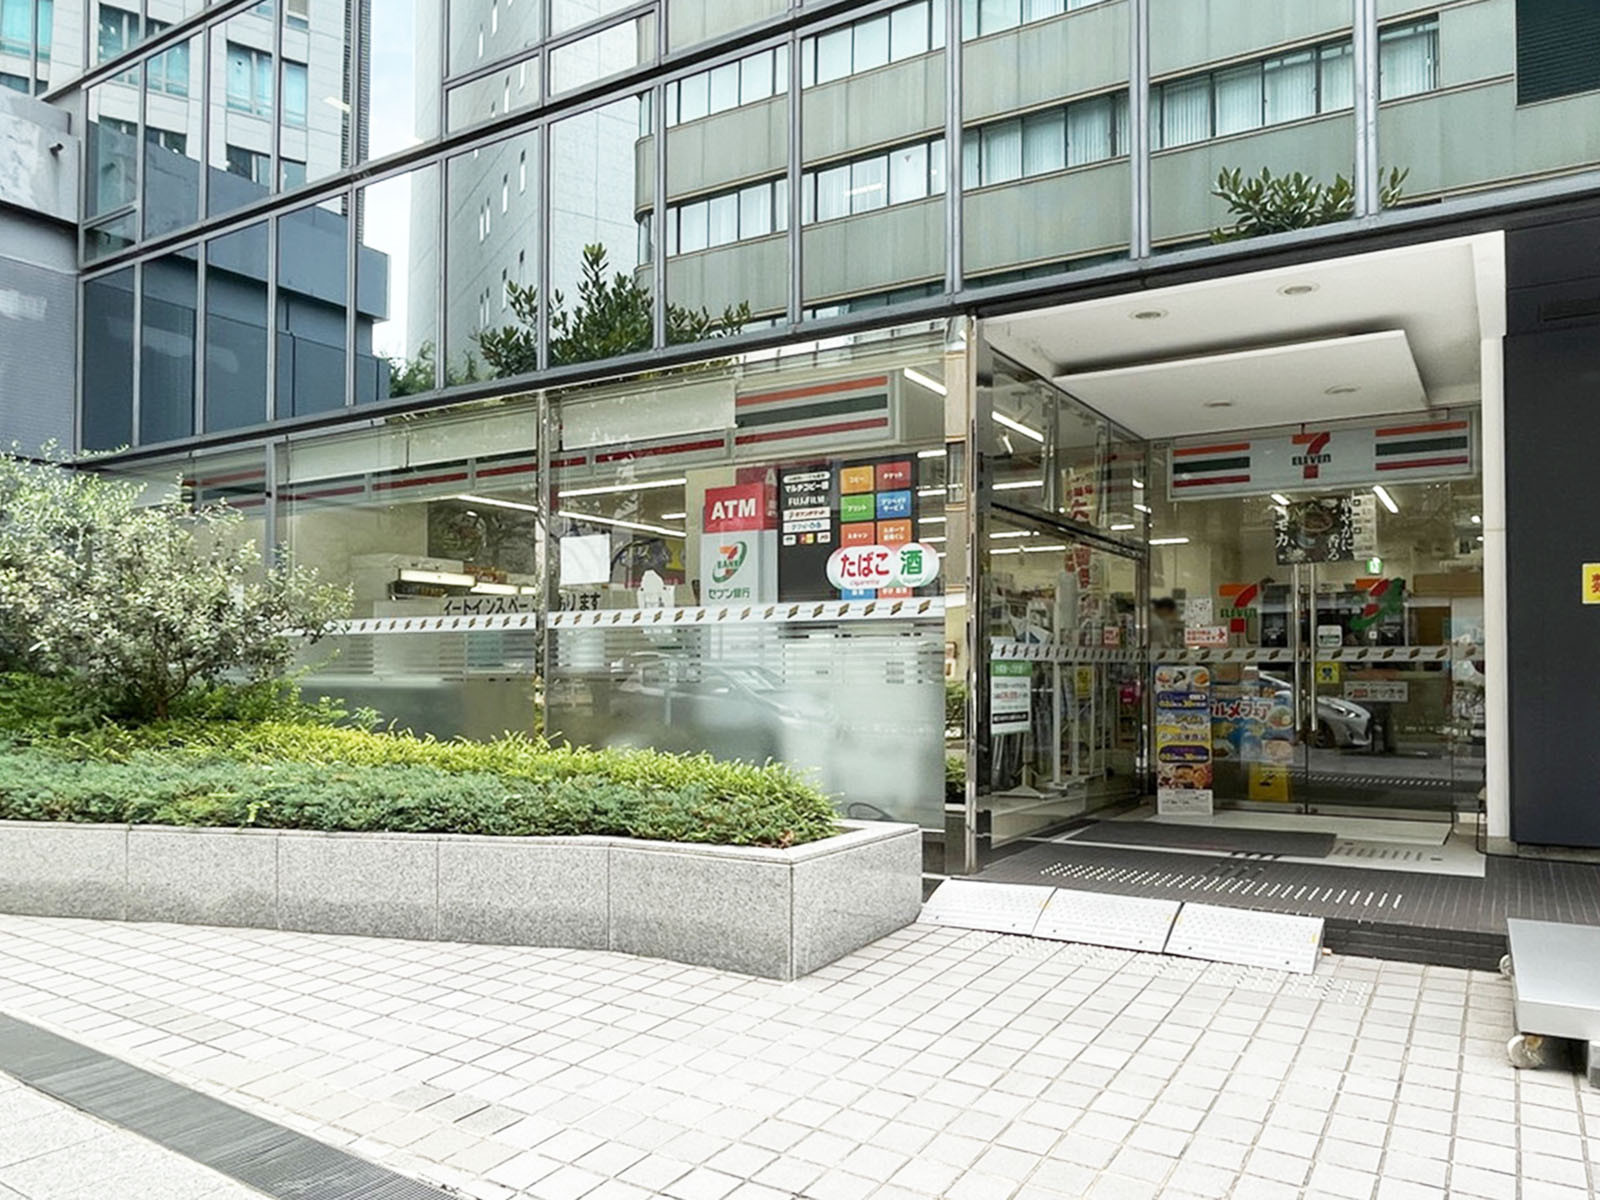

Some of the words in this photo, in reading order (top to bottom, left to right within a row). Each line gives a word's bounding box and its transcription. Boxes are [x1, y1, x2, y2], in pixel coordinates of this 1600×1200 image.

[711, 498, 756, 520] ATM
[841, 551, 890, 577] たばこ
[900, 549, 923, 575] 酒
[708, 586, 750, 600] セブン銀行
